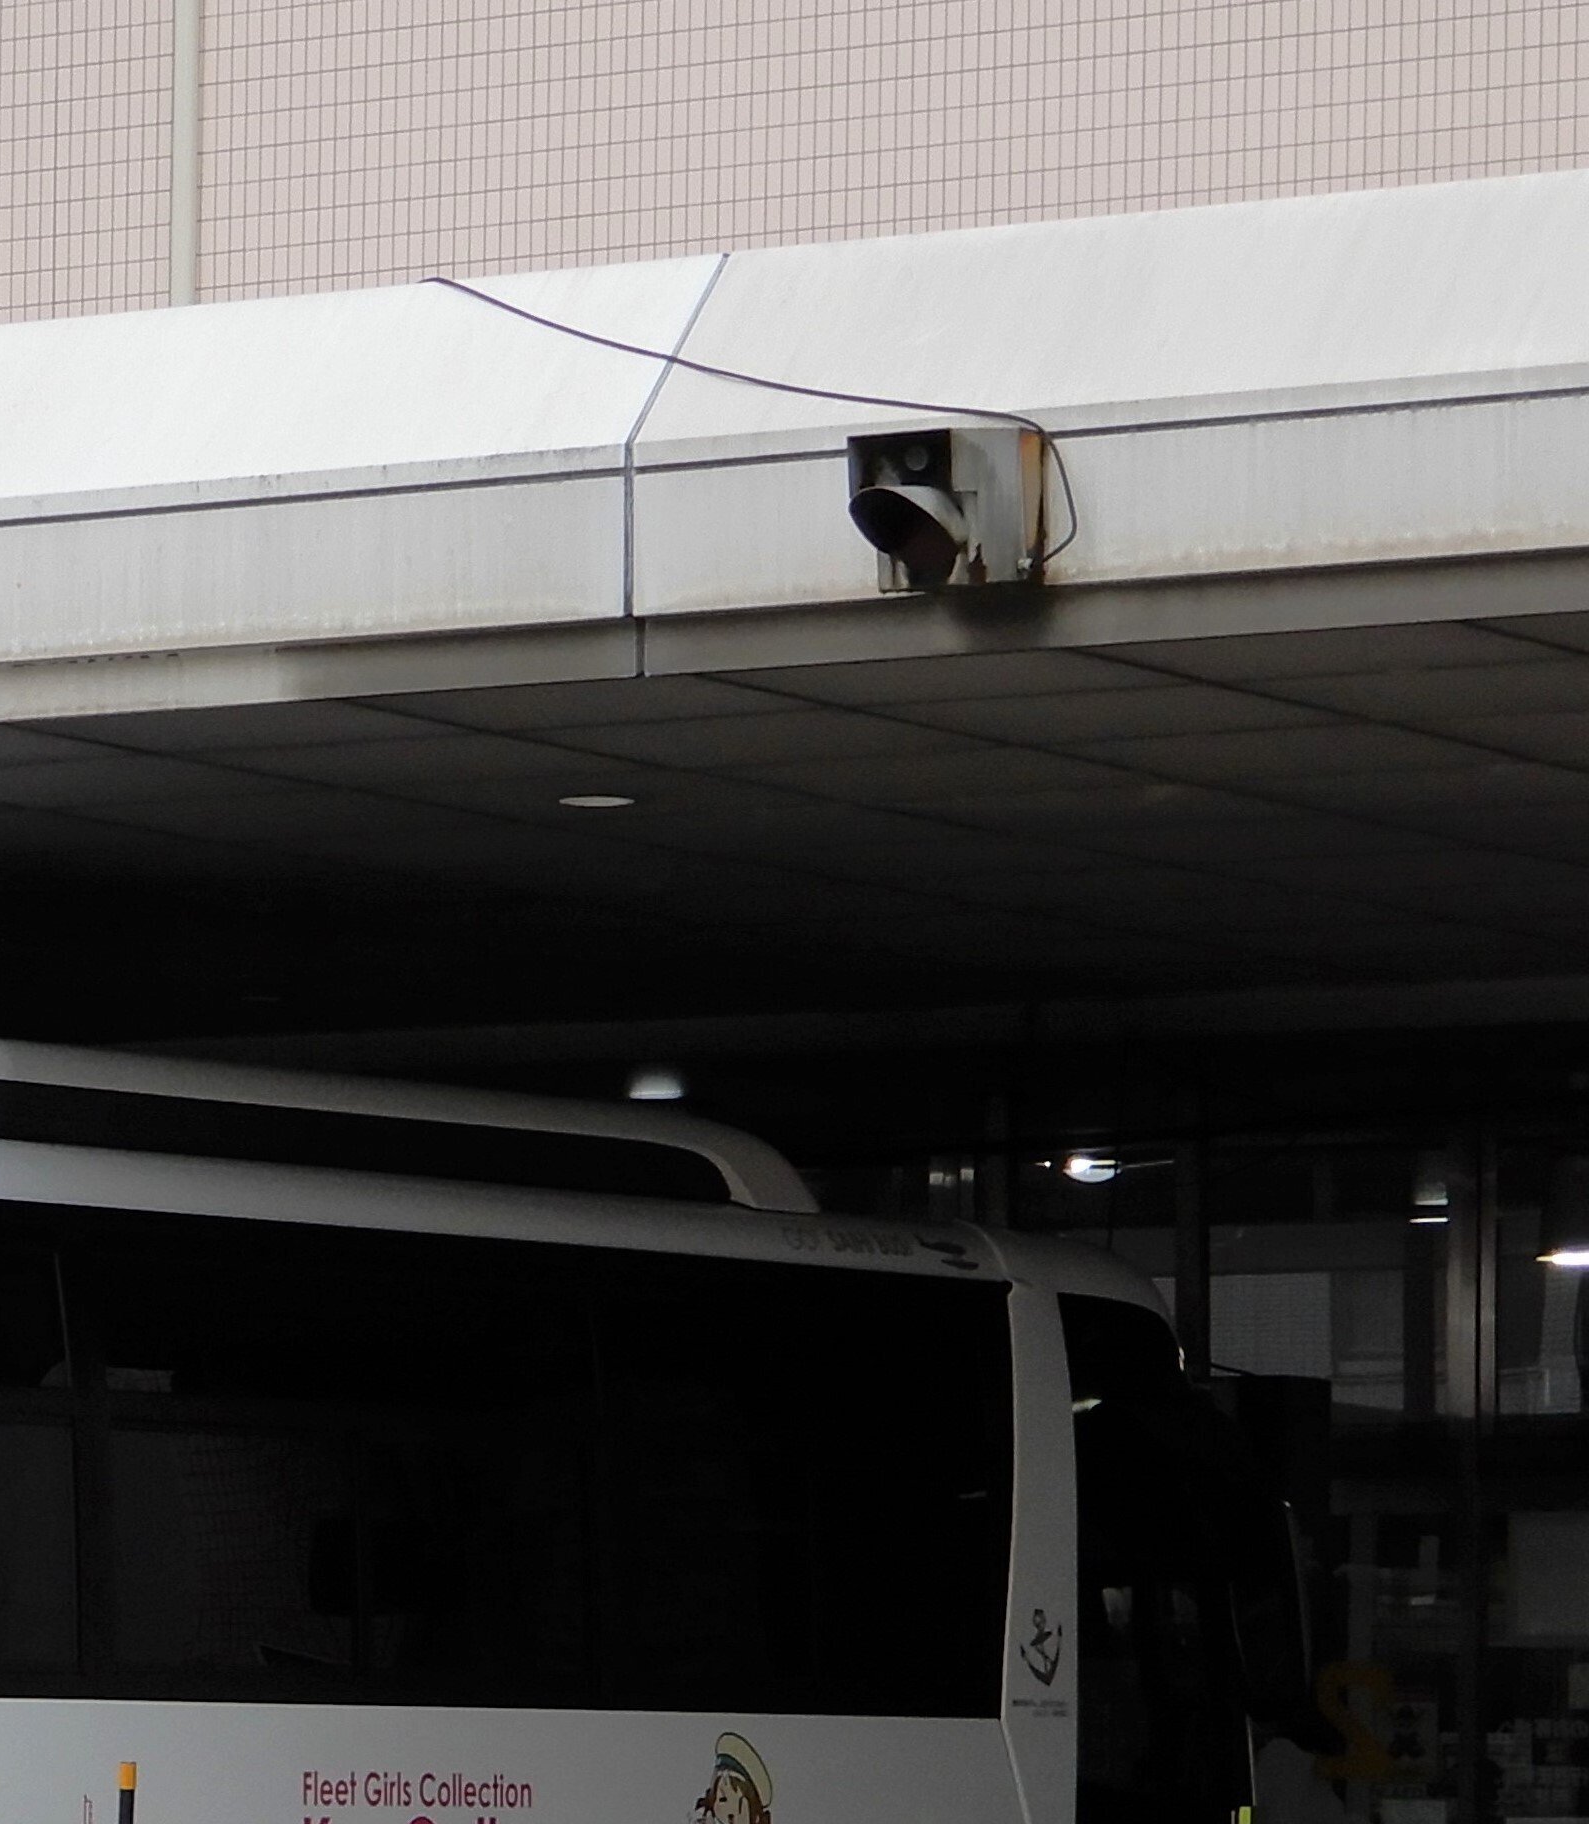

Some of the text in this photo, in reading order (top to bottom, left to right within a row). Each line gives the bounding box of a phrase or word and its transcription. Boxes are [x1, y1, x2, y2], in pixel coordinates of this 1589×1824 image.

[303, 1770, 532, 1808] Fleet Girls Collection
